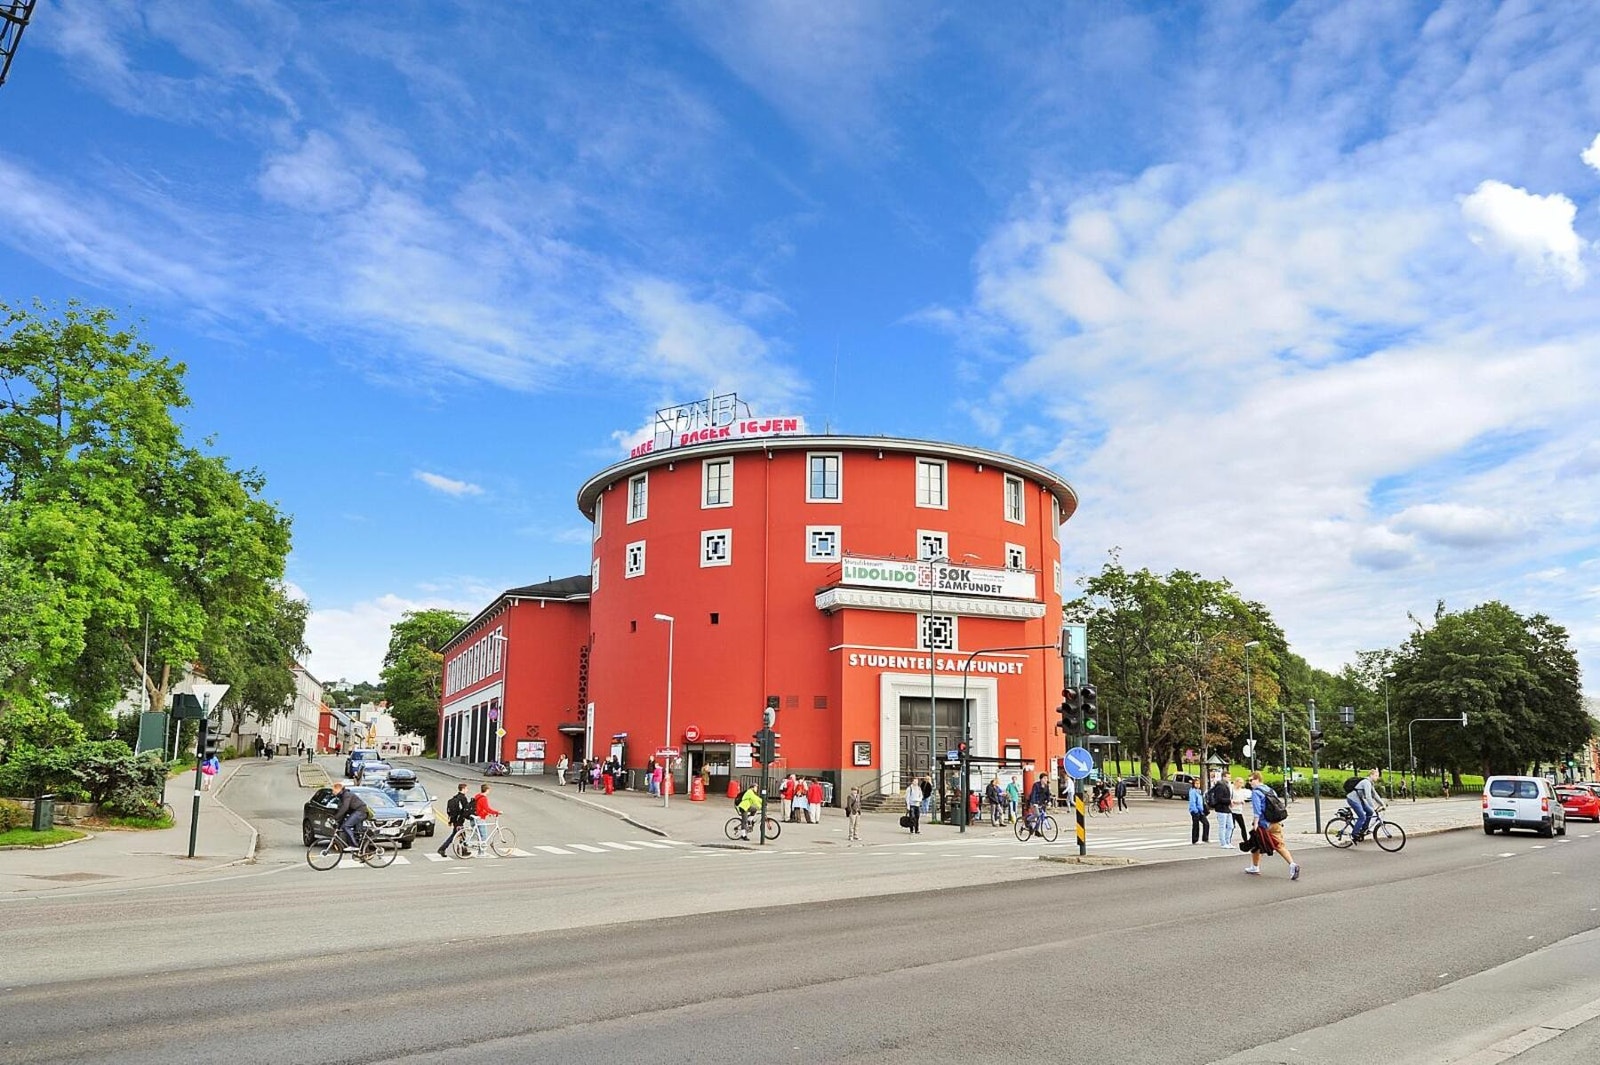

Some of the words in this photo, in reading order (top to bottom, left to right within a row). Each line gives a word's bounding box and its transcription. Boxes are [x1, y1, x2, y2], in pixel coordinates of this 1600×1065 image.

[673, 397, 736, 432] DNB
[631, 440, 654, 459] BARE
[680, 427, 731, 448] DAGER
[740, 419, 797, 433] IGJEN
[844, 566, 917, 583] LIDOLIDO
[939, 568, 971, 582] SØK
[938, 580, 1003, 593] SAMFUNDET
